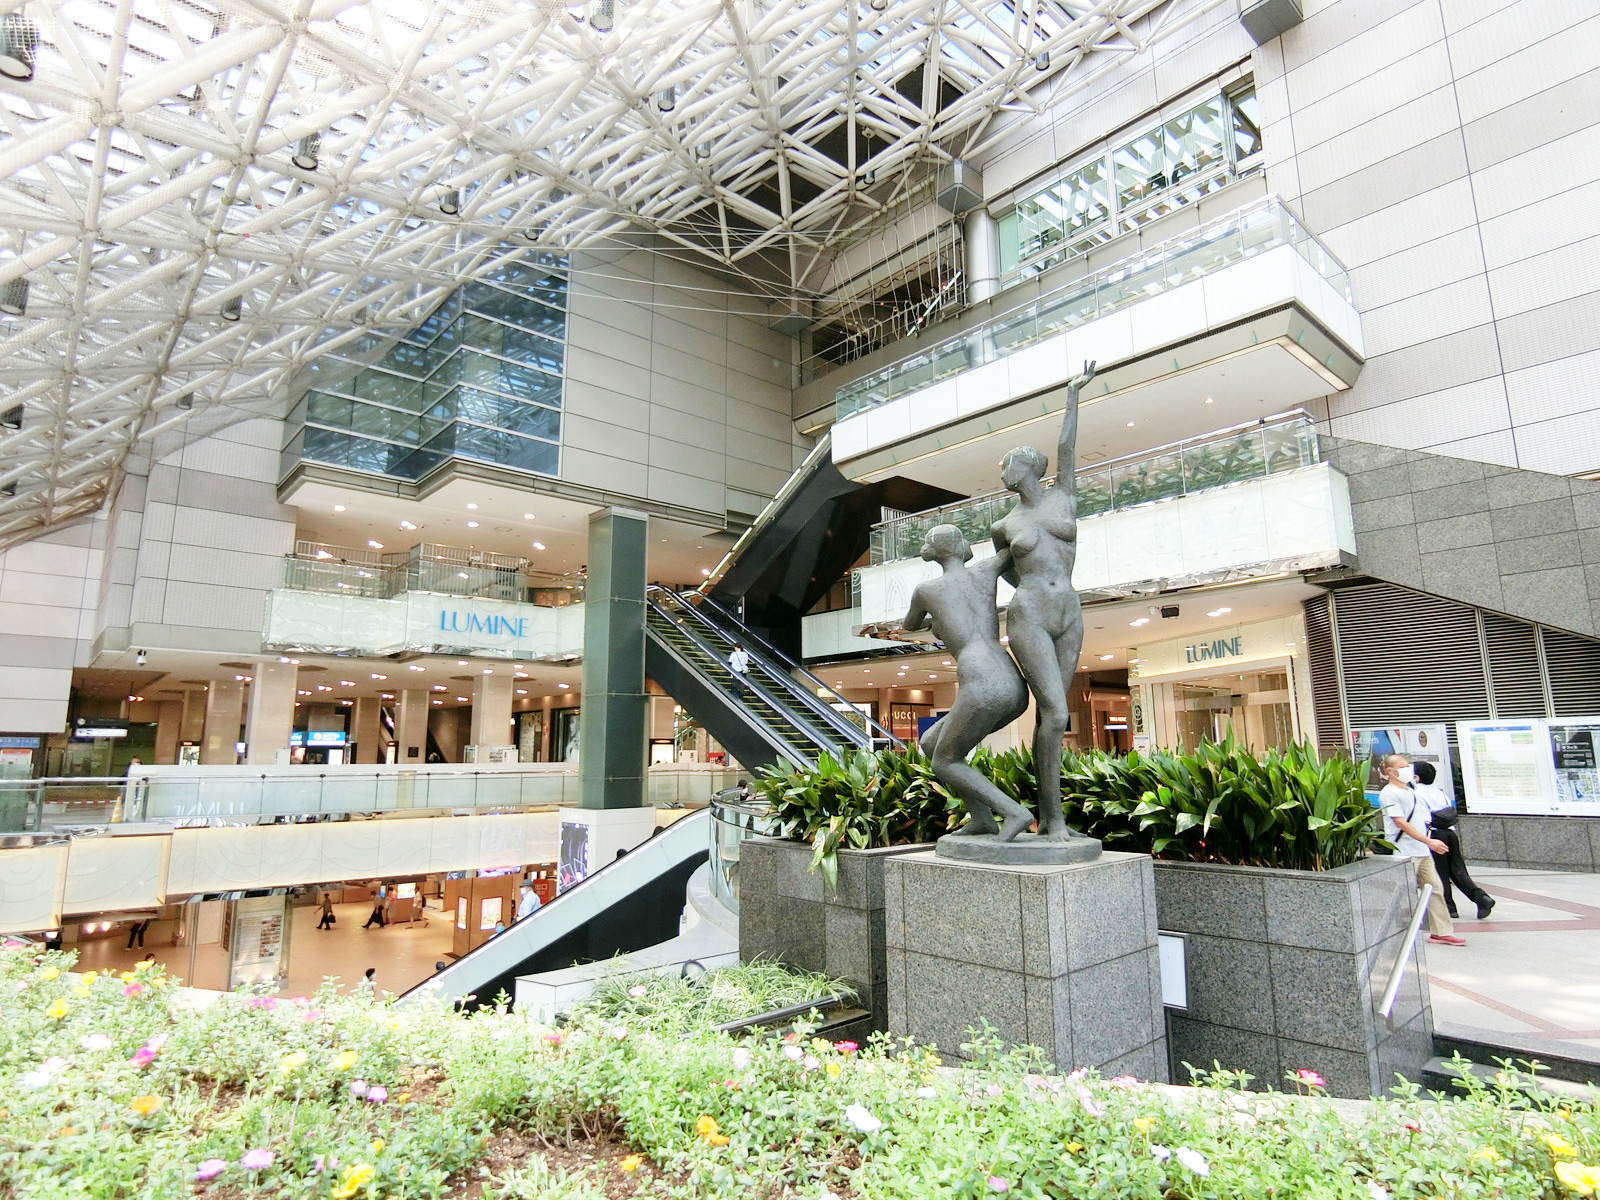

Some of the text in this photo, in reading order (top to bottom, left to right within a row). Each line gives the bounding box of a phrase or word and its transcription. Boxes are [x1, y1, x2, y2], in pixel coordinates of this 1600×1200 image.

[441, 610, 529, 637] LUMINE
[1186, 636, 1243, 663] LUMINE
[892, 711, 916, 720] UCCI
